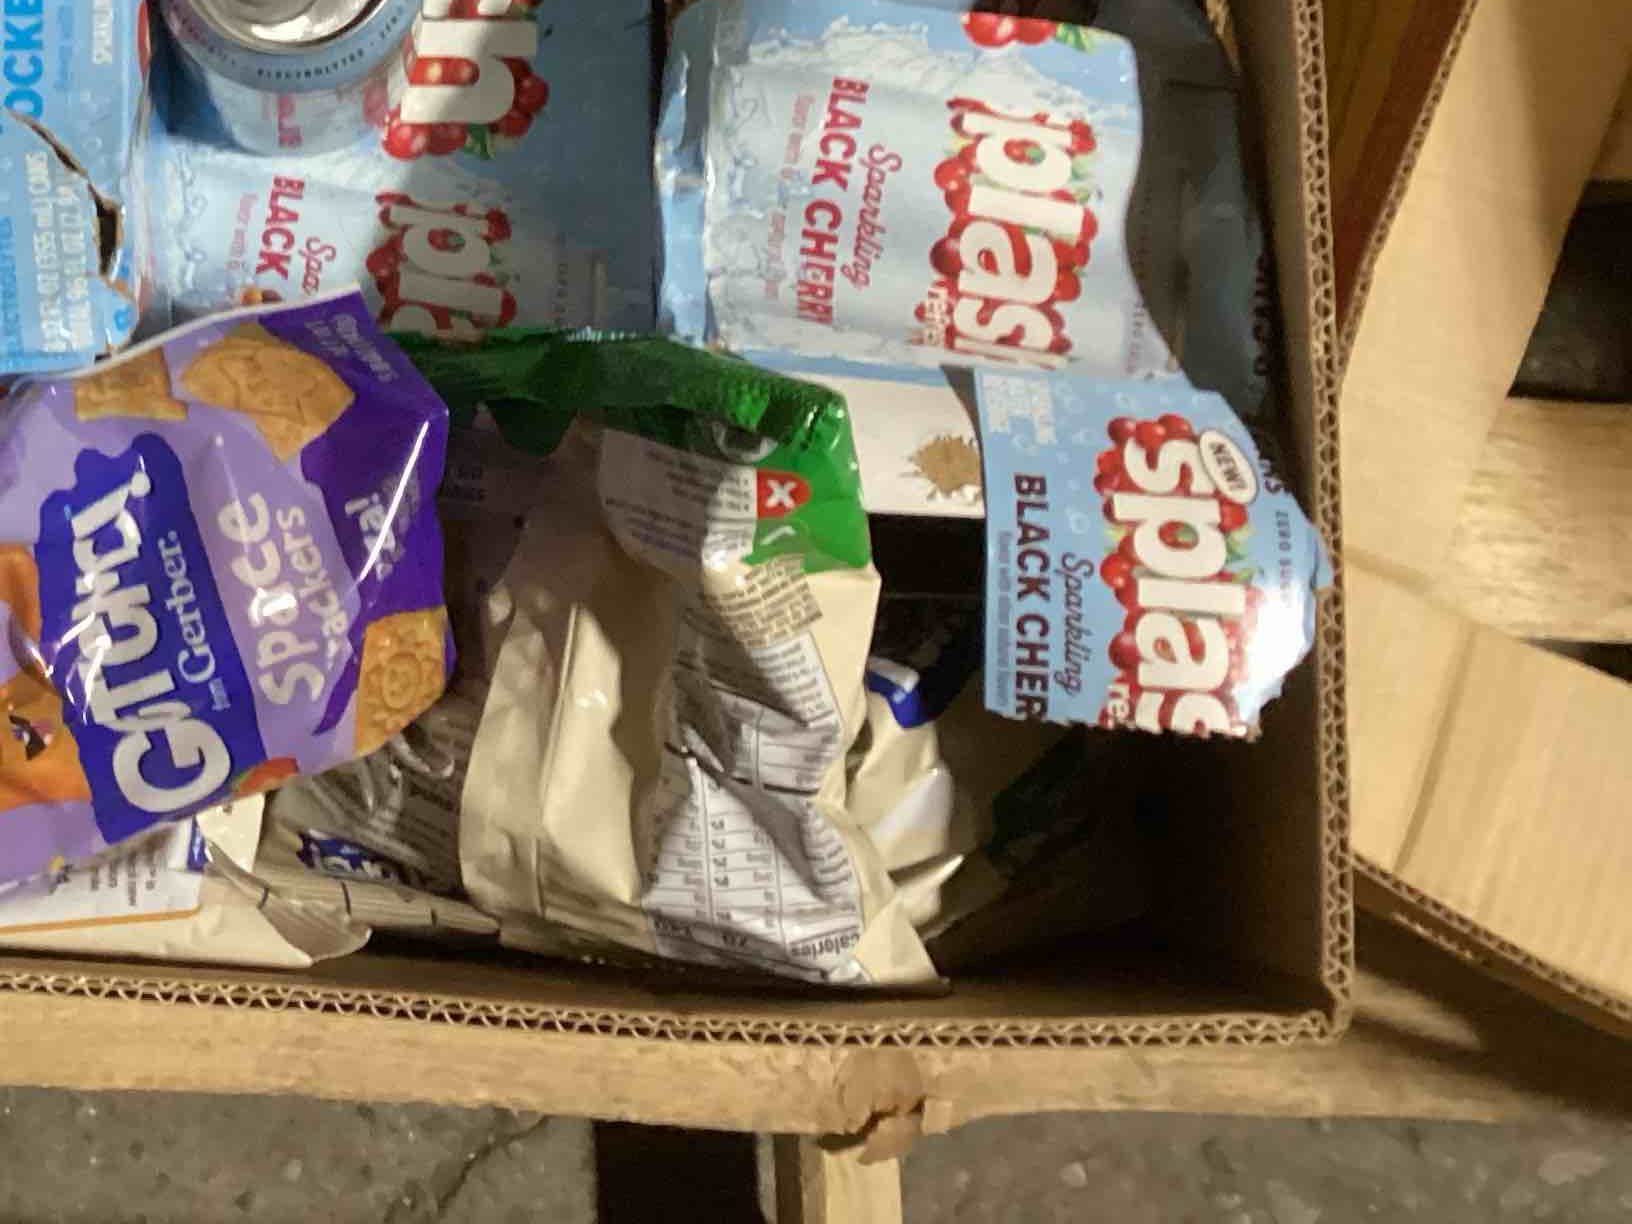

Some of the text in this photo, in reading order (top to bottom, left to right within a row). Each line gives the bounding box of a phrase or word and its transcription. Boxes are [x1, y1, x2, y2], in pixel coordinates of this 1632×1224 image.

[810, 76, 869, 190] BLACK
[841, 143, 903, 290] Sparkling
[1208, 441, 1247, 491] NEW!
[219, 491, 325, 702] Space
[1013, 472, 1050, 600] BLACK
[1051, 552, 1095, 695] Sparkling
